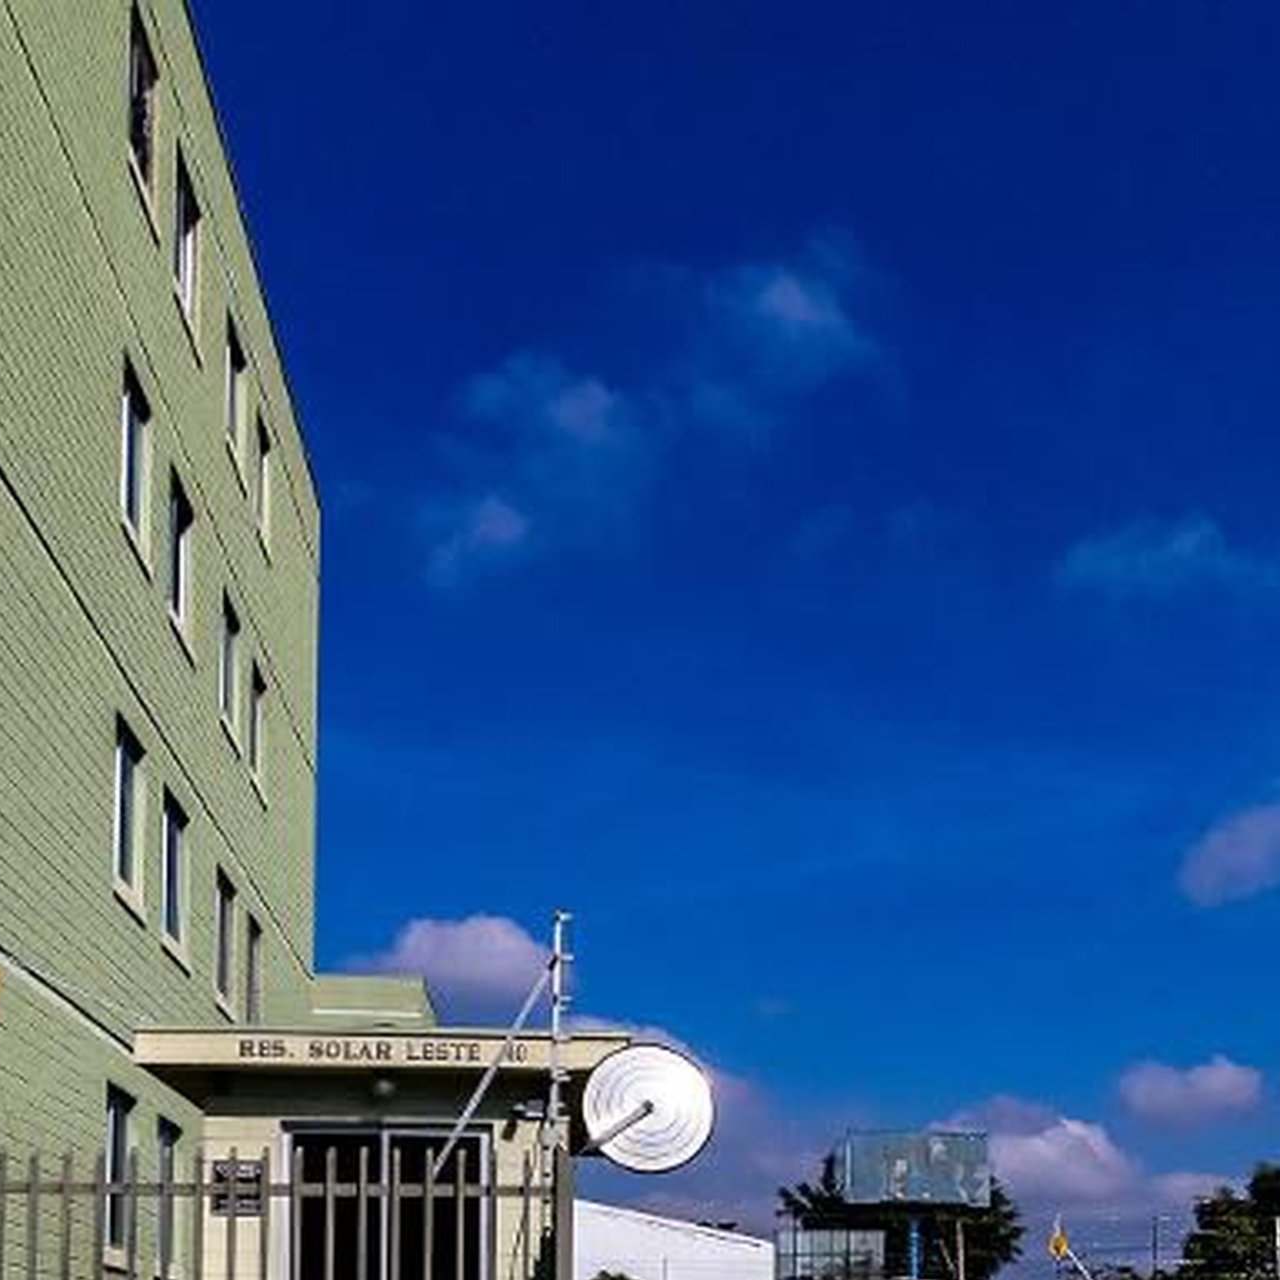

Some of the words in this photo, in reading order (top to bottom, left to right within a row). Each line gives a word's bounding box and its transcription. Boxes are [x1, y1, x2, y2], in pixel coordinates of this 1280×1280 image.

[238, 1038, 294, 1059] RES.
[308, 1040, 392, 1061] SOLAR
[406, 1040, 481, 1062] LESTE
